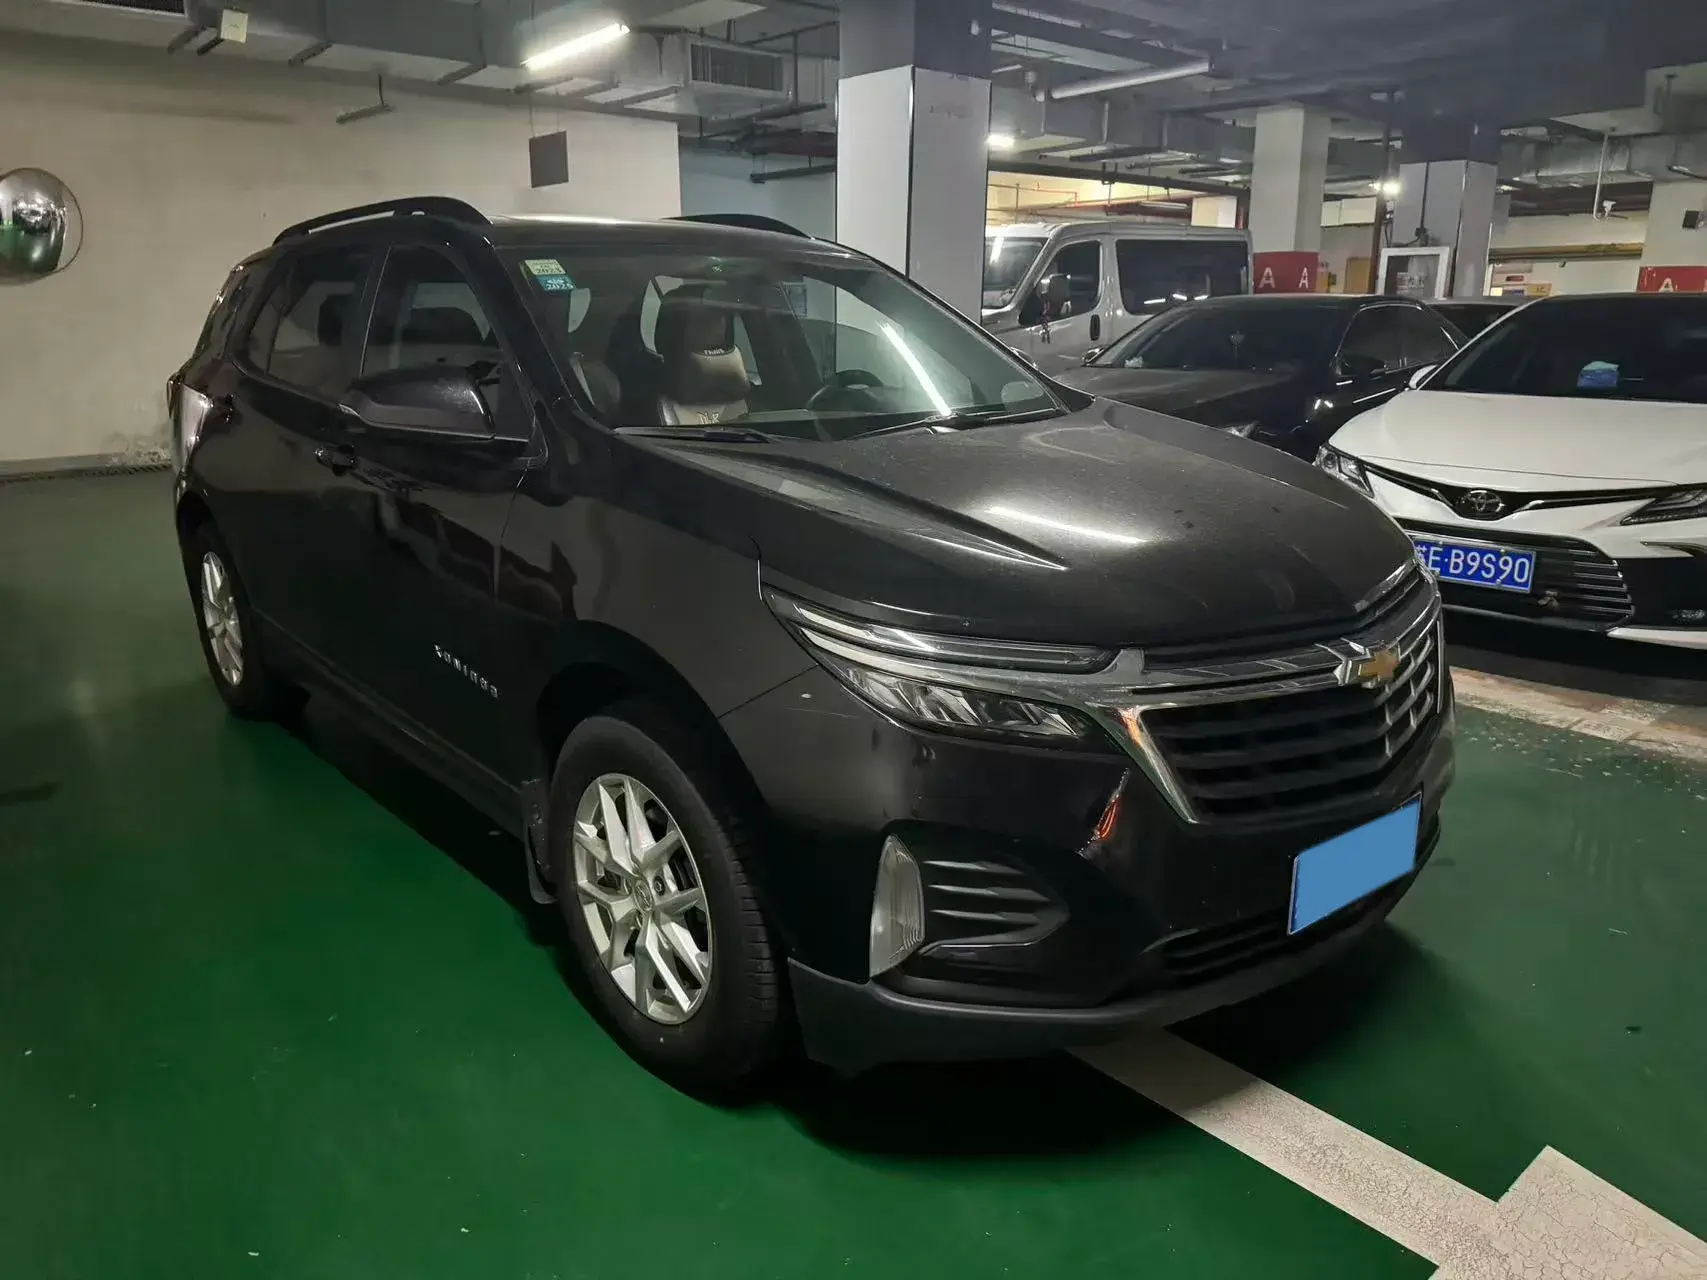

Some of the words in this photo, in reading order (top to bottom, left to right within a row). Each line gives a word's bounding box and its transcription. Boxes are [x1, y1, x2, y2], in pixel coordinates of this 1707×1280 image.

[1259, 266, 1276, 288] A
[1299, 266, 1309, 288] A
[1659, 277, 1674, 292] A
